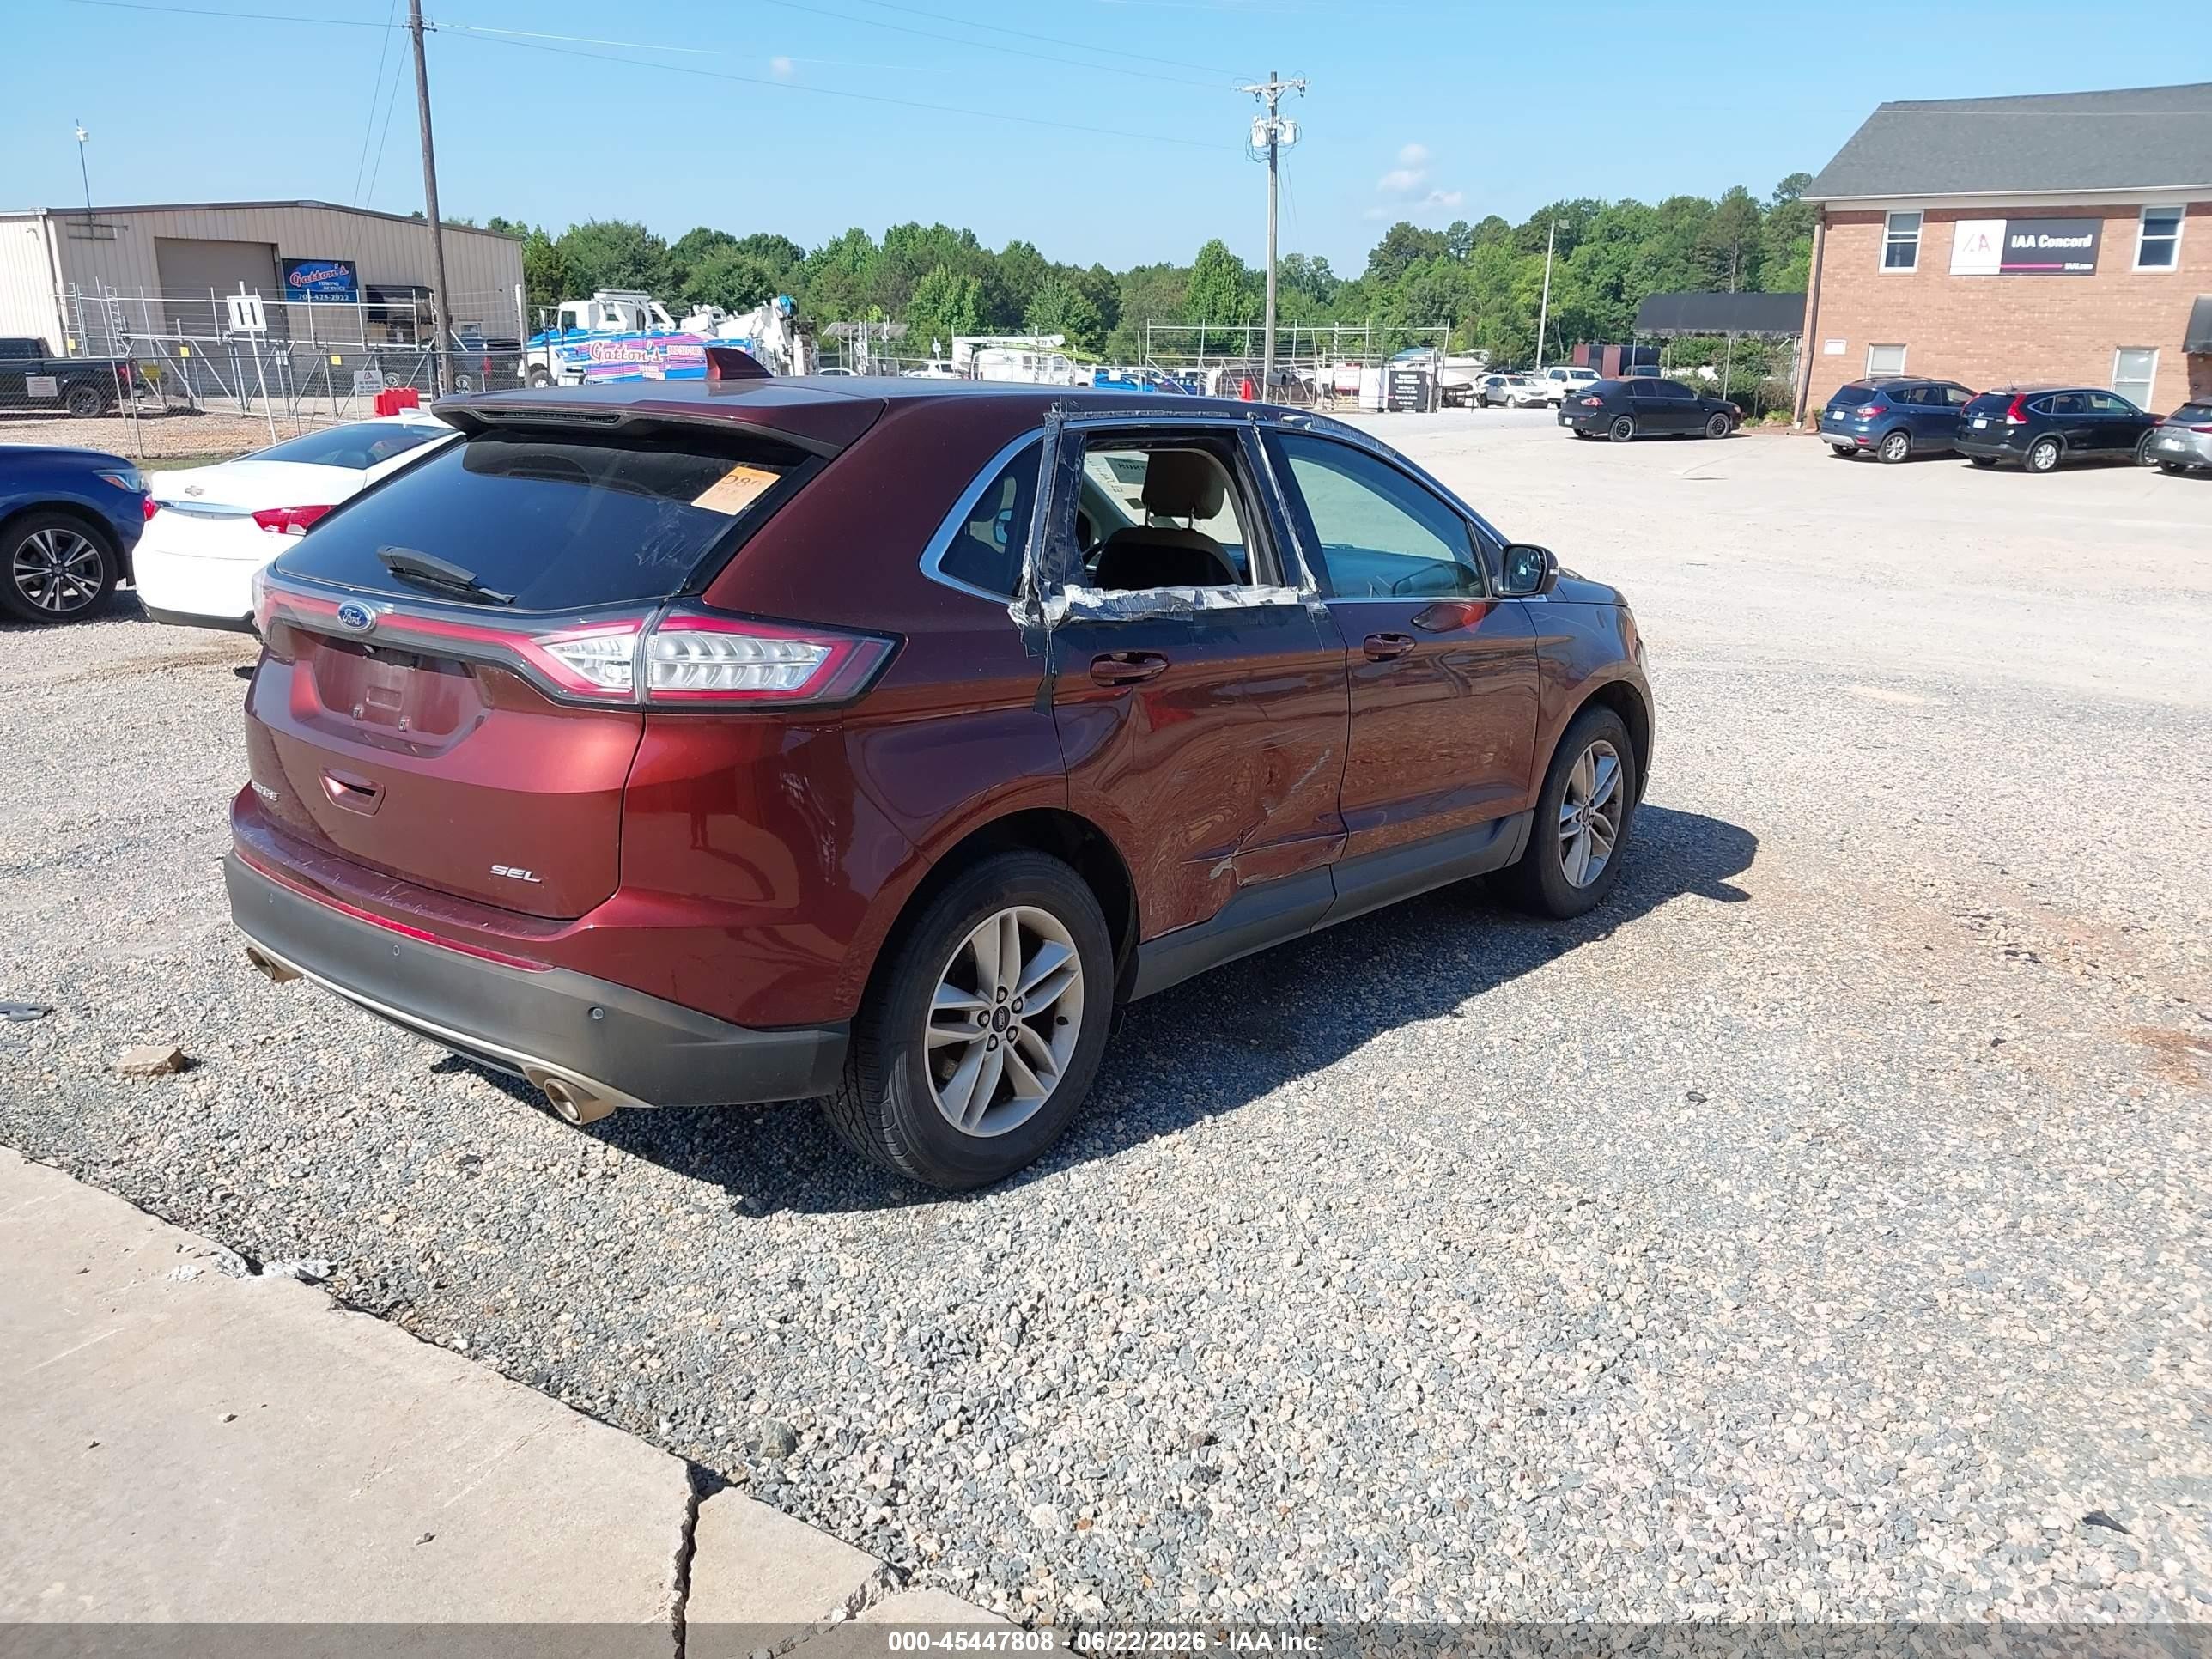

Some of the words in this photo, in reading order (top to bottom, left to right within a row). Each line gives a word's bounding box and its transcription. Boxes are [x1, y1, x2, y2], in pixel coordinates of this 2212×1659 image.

[2011, 234, 2036, 248] IAA
[2039, 234, 2093, 248] Concord
[489, 864, 543, 884] SEL
